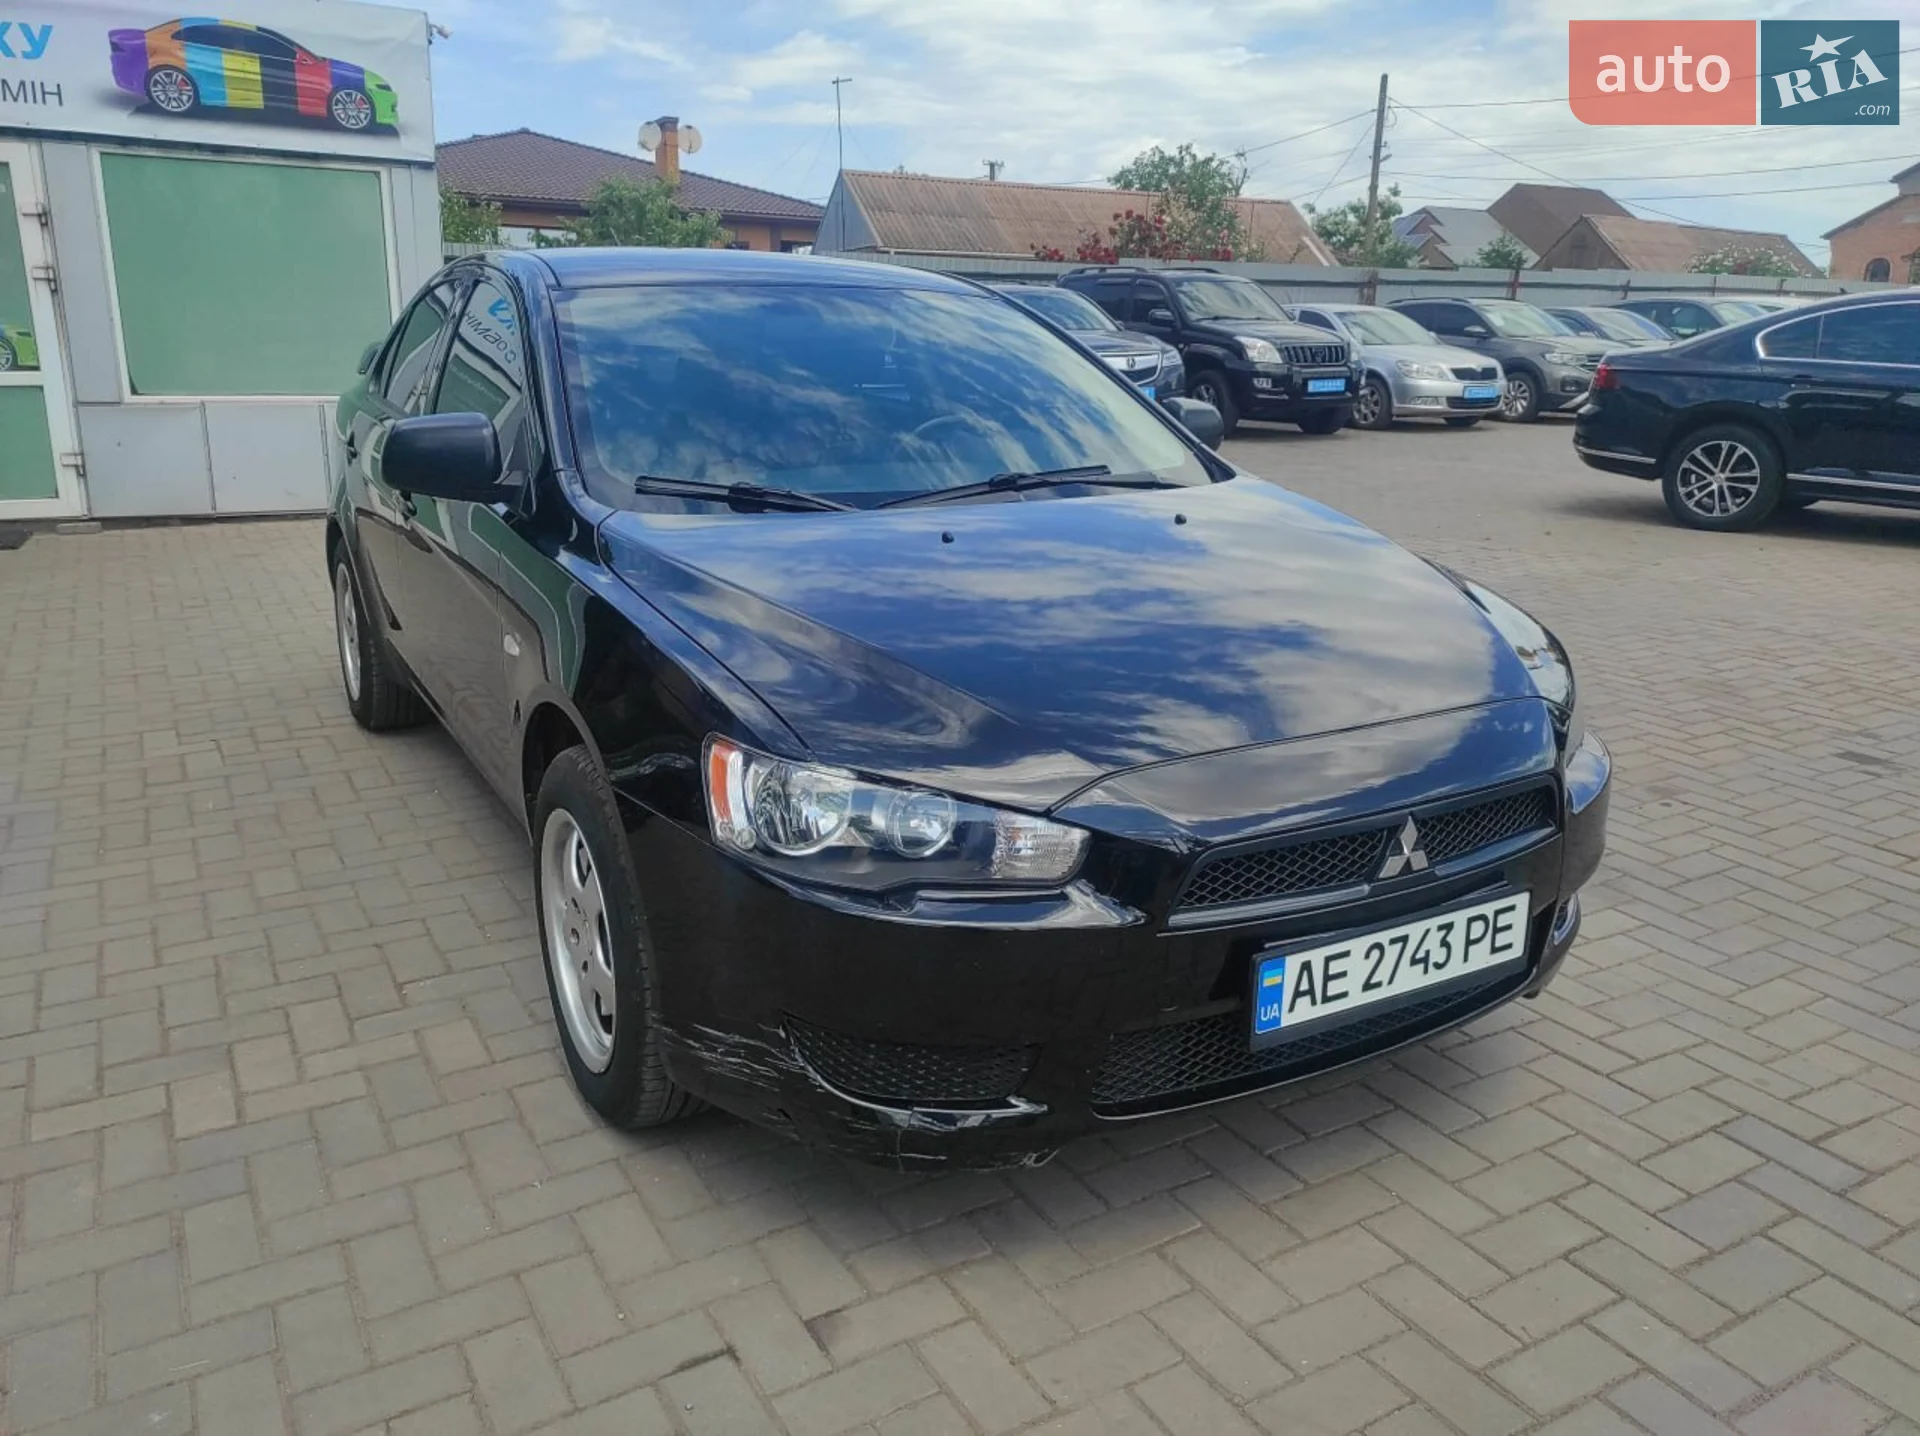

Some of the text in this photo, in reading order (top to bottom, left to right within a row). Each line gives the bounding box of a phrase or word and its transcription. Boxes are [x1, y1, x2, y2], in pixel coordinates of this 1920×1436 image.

[1288, 904, 1517, 1013] AE 2743 PE
[1260, 1006, 1280, 1022] UA
